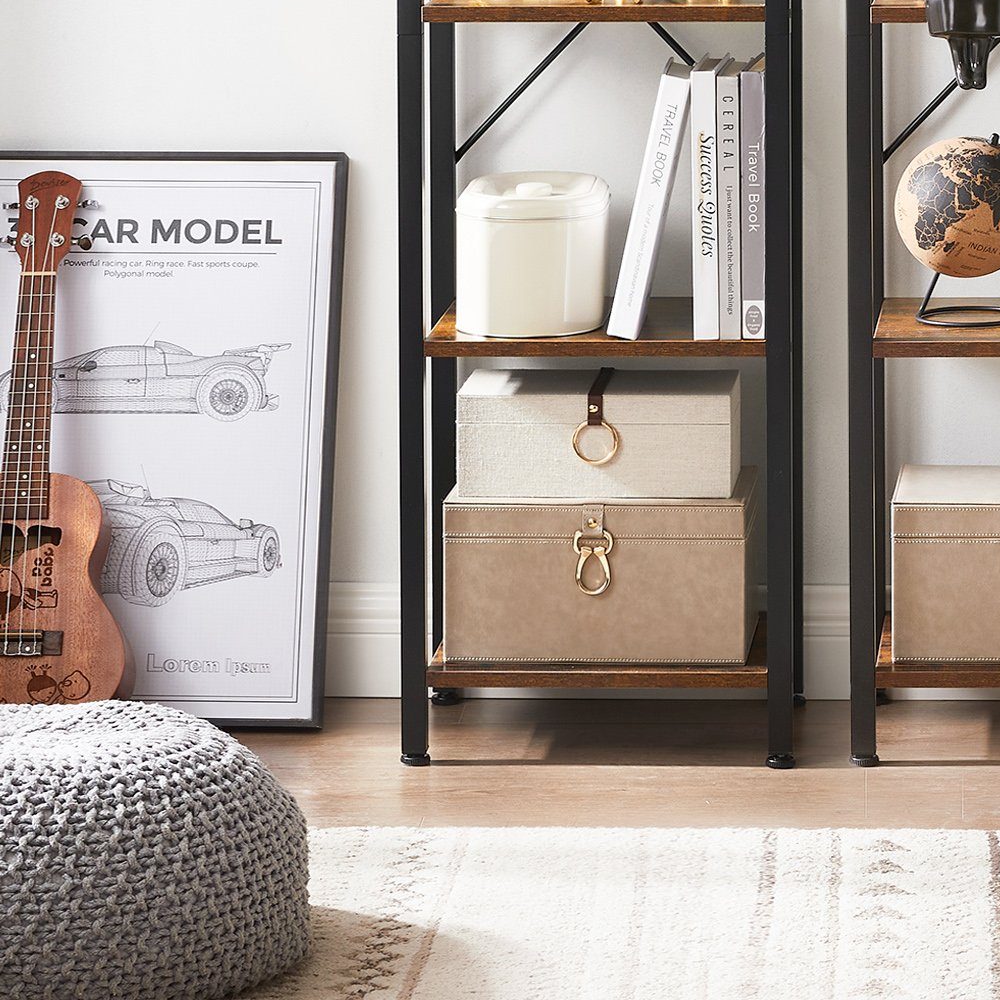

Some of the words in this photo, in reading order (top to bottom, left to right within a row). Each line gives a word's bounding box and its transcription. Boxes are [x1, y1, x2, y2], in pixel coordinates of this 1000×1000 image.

[658, 104, 678, 147] TRAVEL
[722, 95, 735, 171] CEREAL
[650, 151, 668, 187] BOOK
[699, 131, 714, 195] Success
[748, 142, 761, 187] Travel
[725, 189, 733, 202] just
[726, 220, 733, 228] to
[748, 193, 761, 233] Book
[150, 218, 283, 245] MODEL
[697, 199, 716, 258] Quotes
[726, 228, 734, 251] collect
[967, 241, 998, 255] INDIAN
[63, 259, 100, 268] Powerful
[102, 260, 128, 269] racing
[145, 260, 165, 269] Ring
[188, 260, 204, 268] Fast
[206, 260, 231, 269] sports
[104, 269, 144, 278] Polygonal
[727, 263, 735, 293] beautiful
[727, 294, 735, 315] things
[146, 652, 220, 673] Lorem
[225, 657, 272, 677] Ipsum
